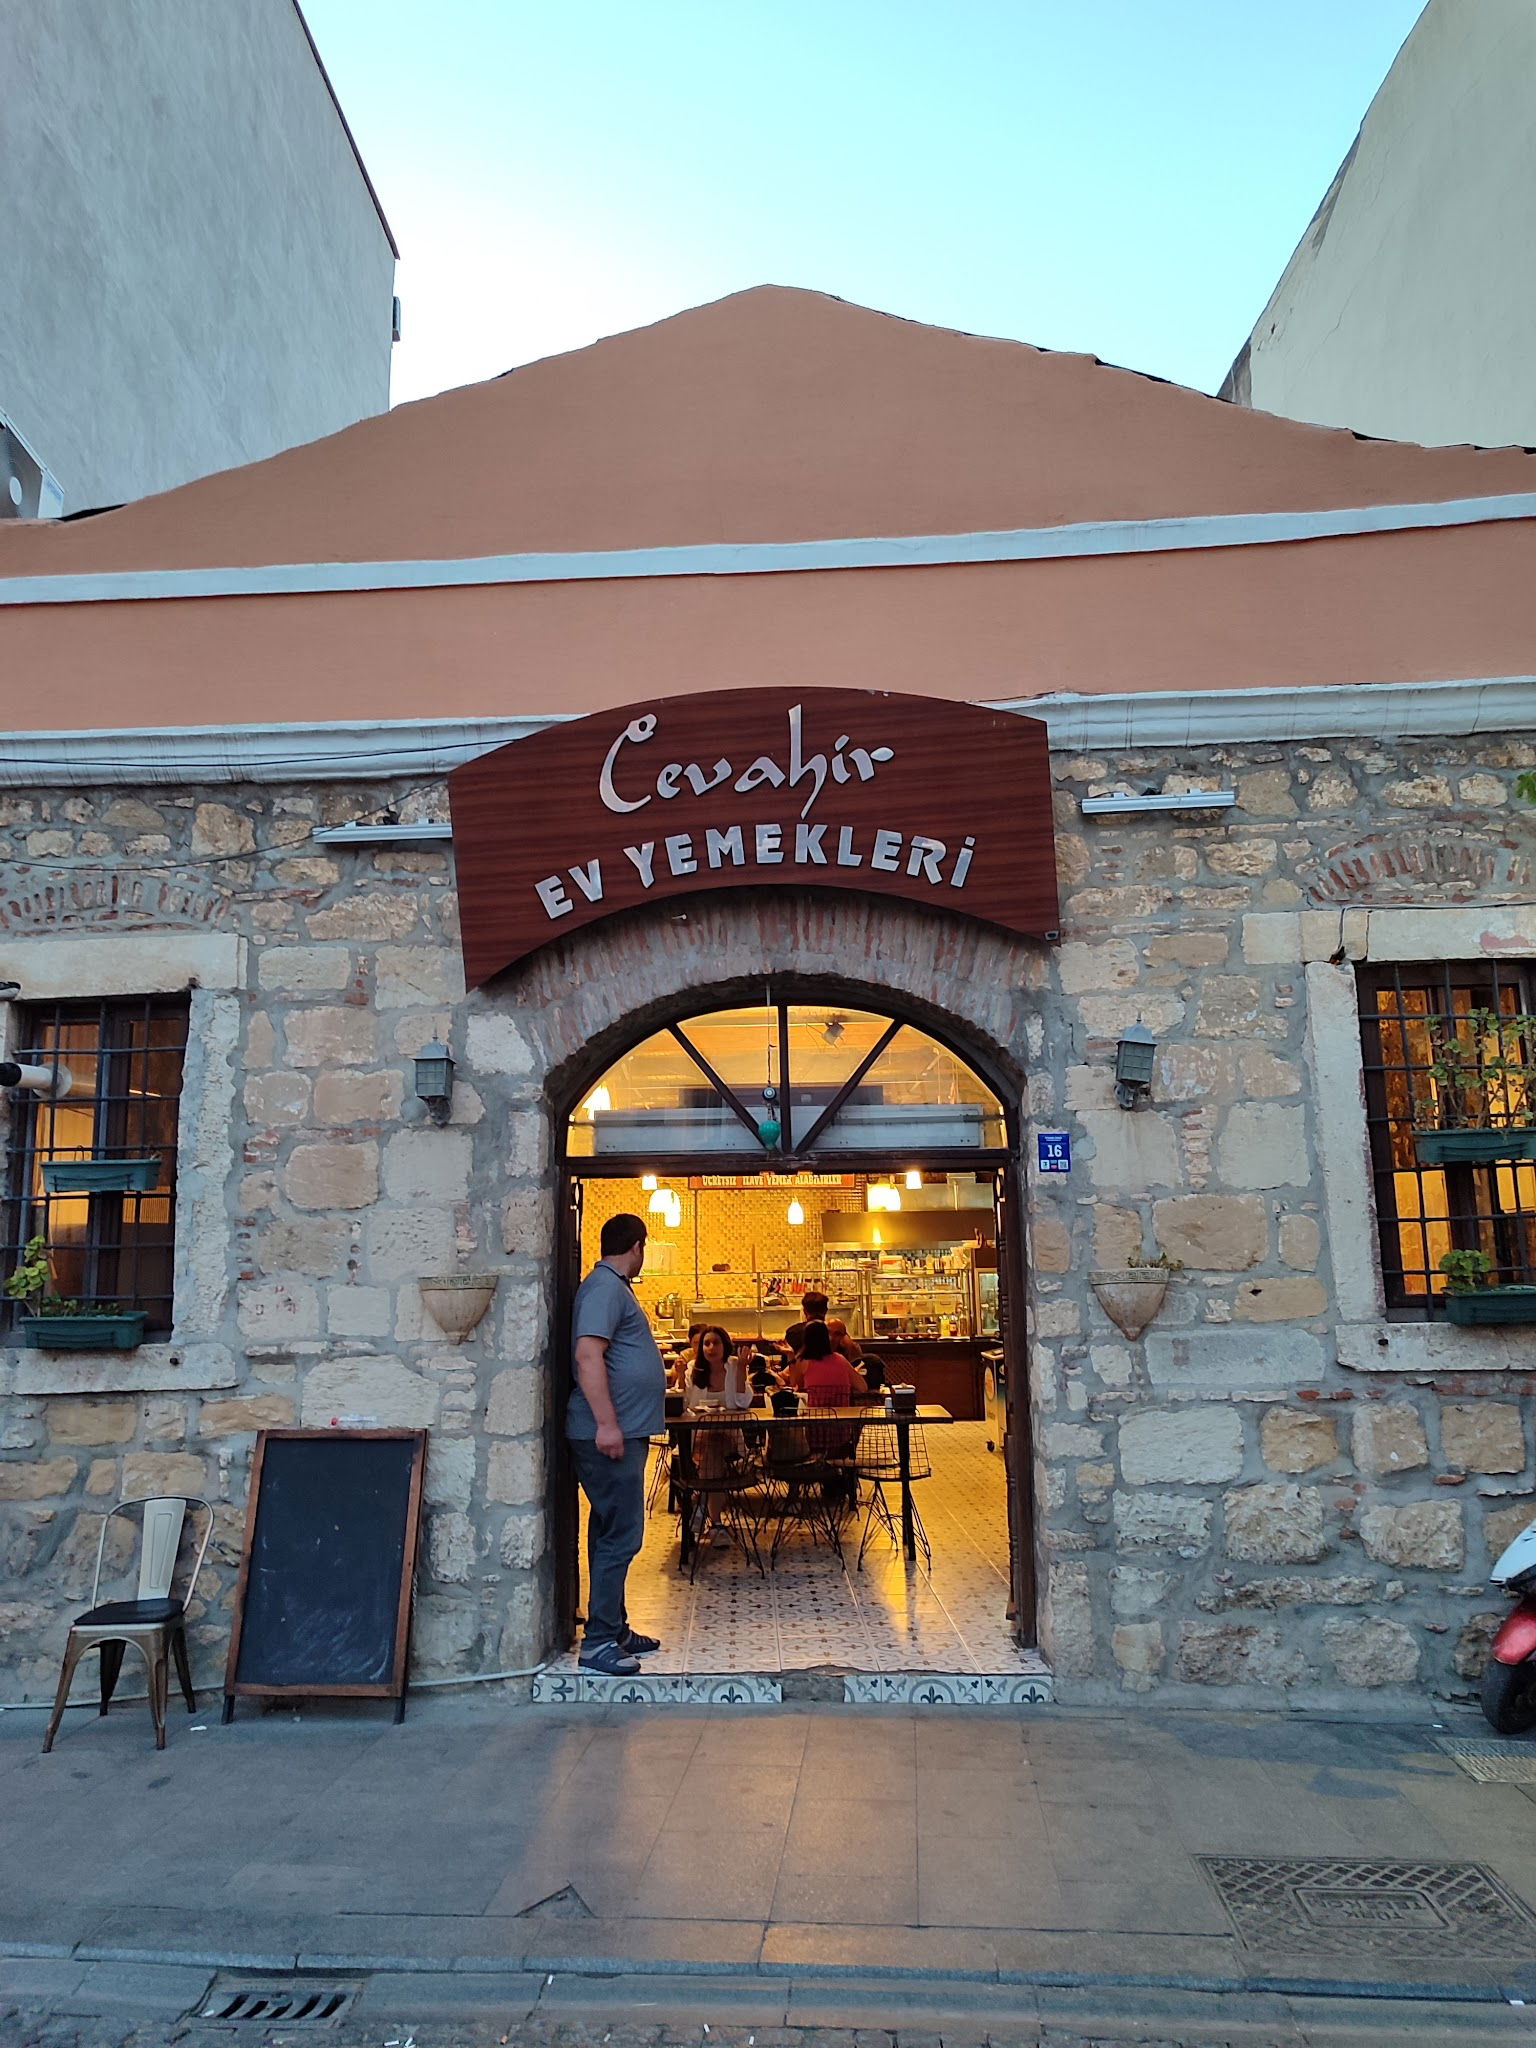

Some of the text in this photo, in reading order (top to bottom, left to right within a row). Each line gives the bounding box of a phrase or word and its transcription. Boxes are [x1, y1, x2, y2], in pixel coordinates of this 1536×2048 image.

[600, 704, 895, 819] Cevahir
[535, 823, 976, 920] EV YEMEKLERİ
[1047, 1144, 1062, 1157] 16
